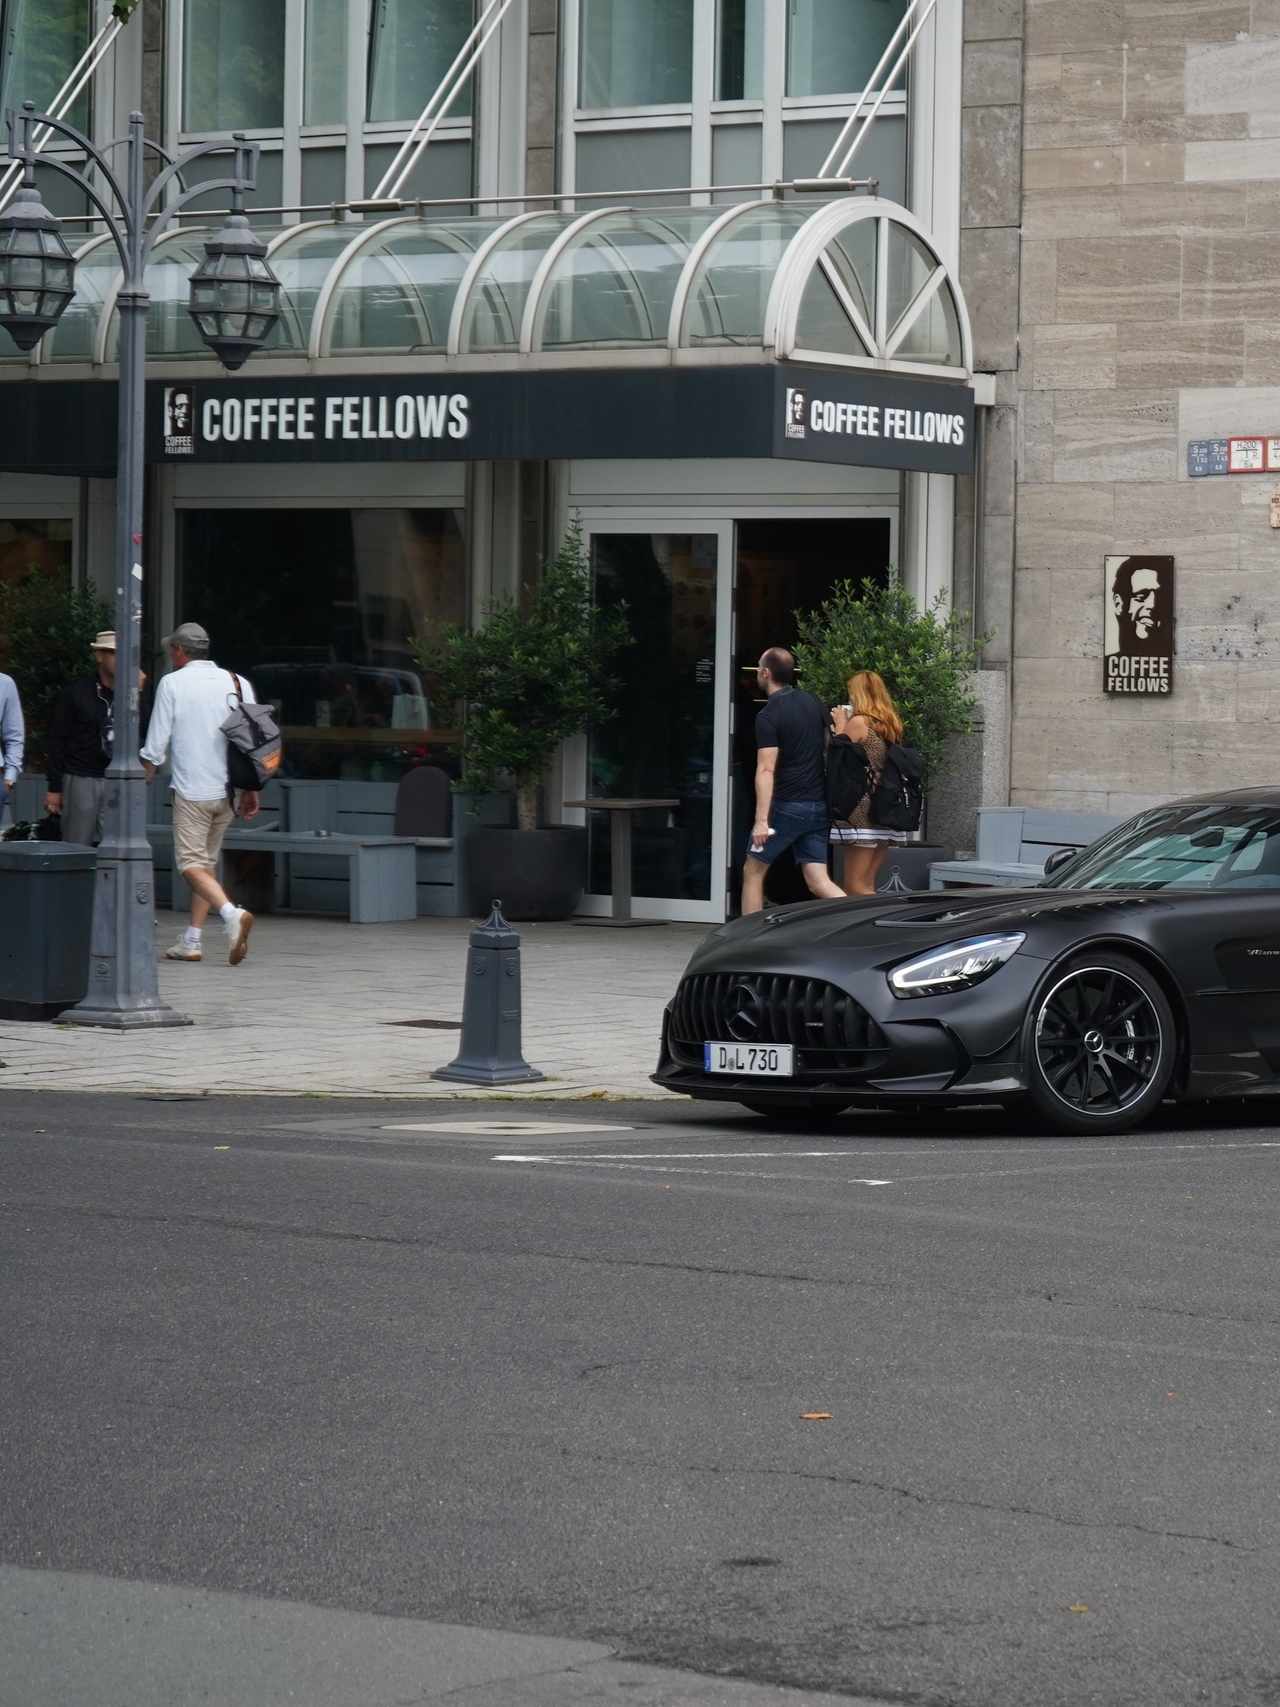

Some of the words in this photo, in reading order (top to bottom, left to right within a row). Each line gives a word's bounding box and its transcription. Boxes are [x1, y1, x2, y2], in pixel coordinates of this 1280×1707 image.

[203, 397, 315, 442] COFFEE
[325, 393, 469, 440] FELLOWS
[810, 399, 880, 437] COFFEE
[884, 407, 964, 446] FELLOWS
[165, 435, 192, 446] COFFEE
[1108, 656, 1169, 677] COFFEE
[1108, 677, 1169, 693] FELLOWS
